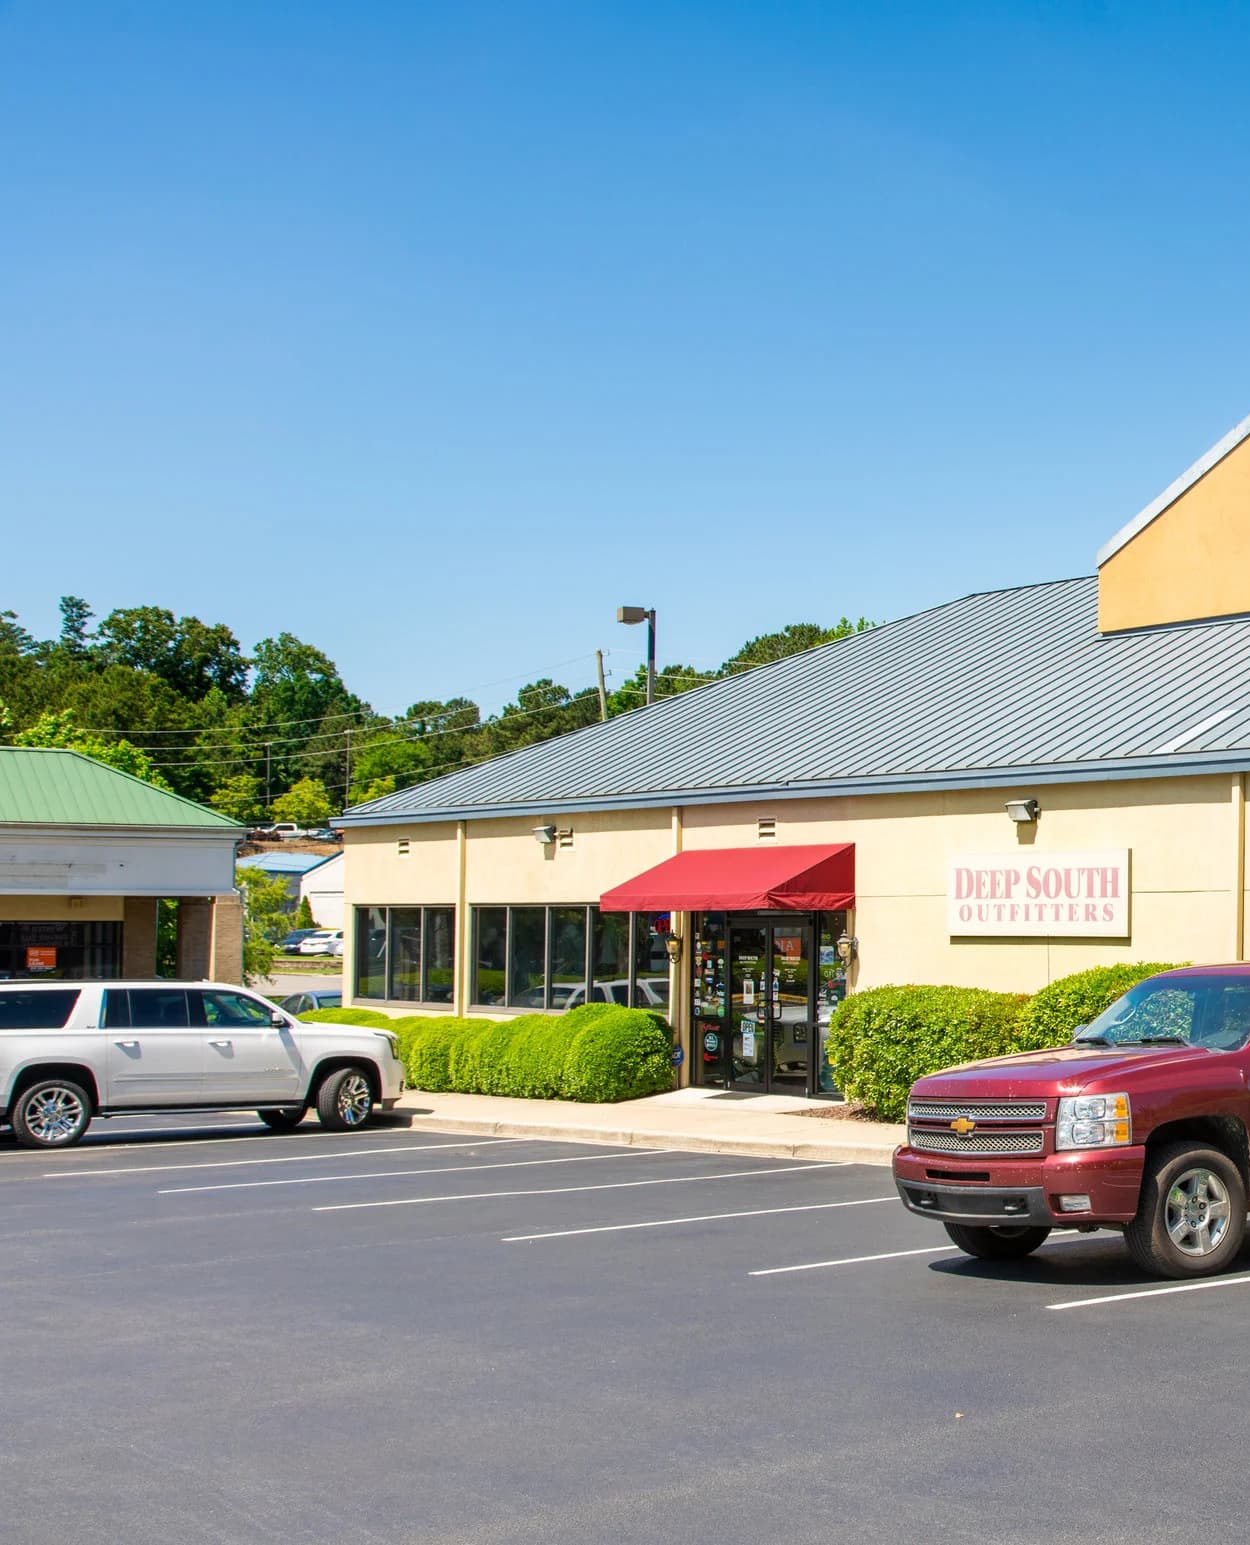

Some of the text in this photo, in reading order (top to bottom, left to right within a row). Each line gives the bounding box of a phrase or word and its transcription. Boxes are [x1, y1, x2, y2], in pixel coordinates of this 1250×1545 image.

[954, 865, 1121, 900] DEEP SOUTH
[958, 902, 1115, 923] OUTFITTERS
